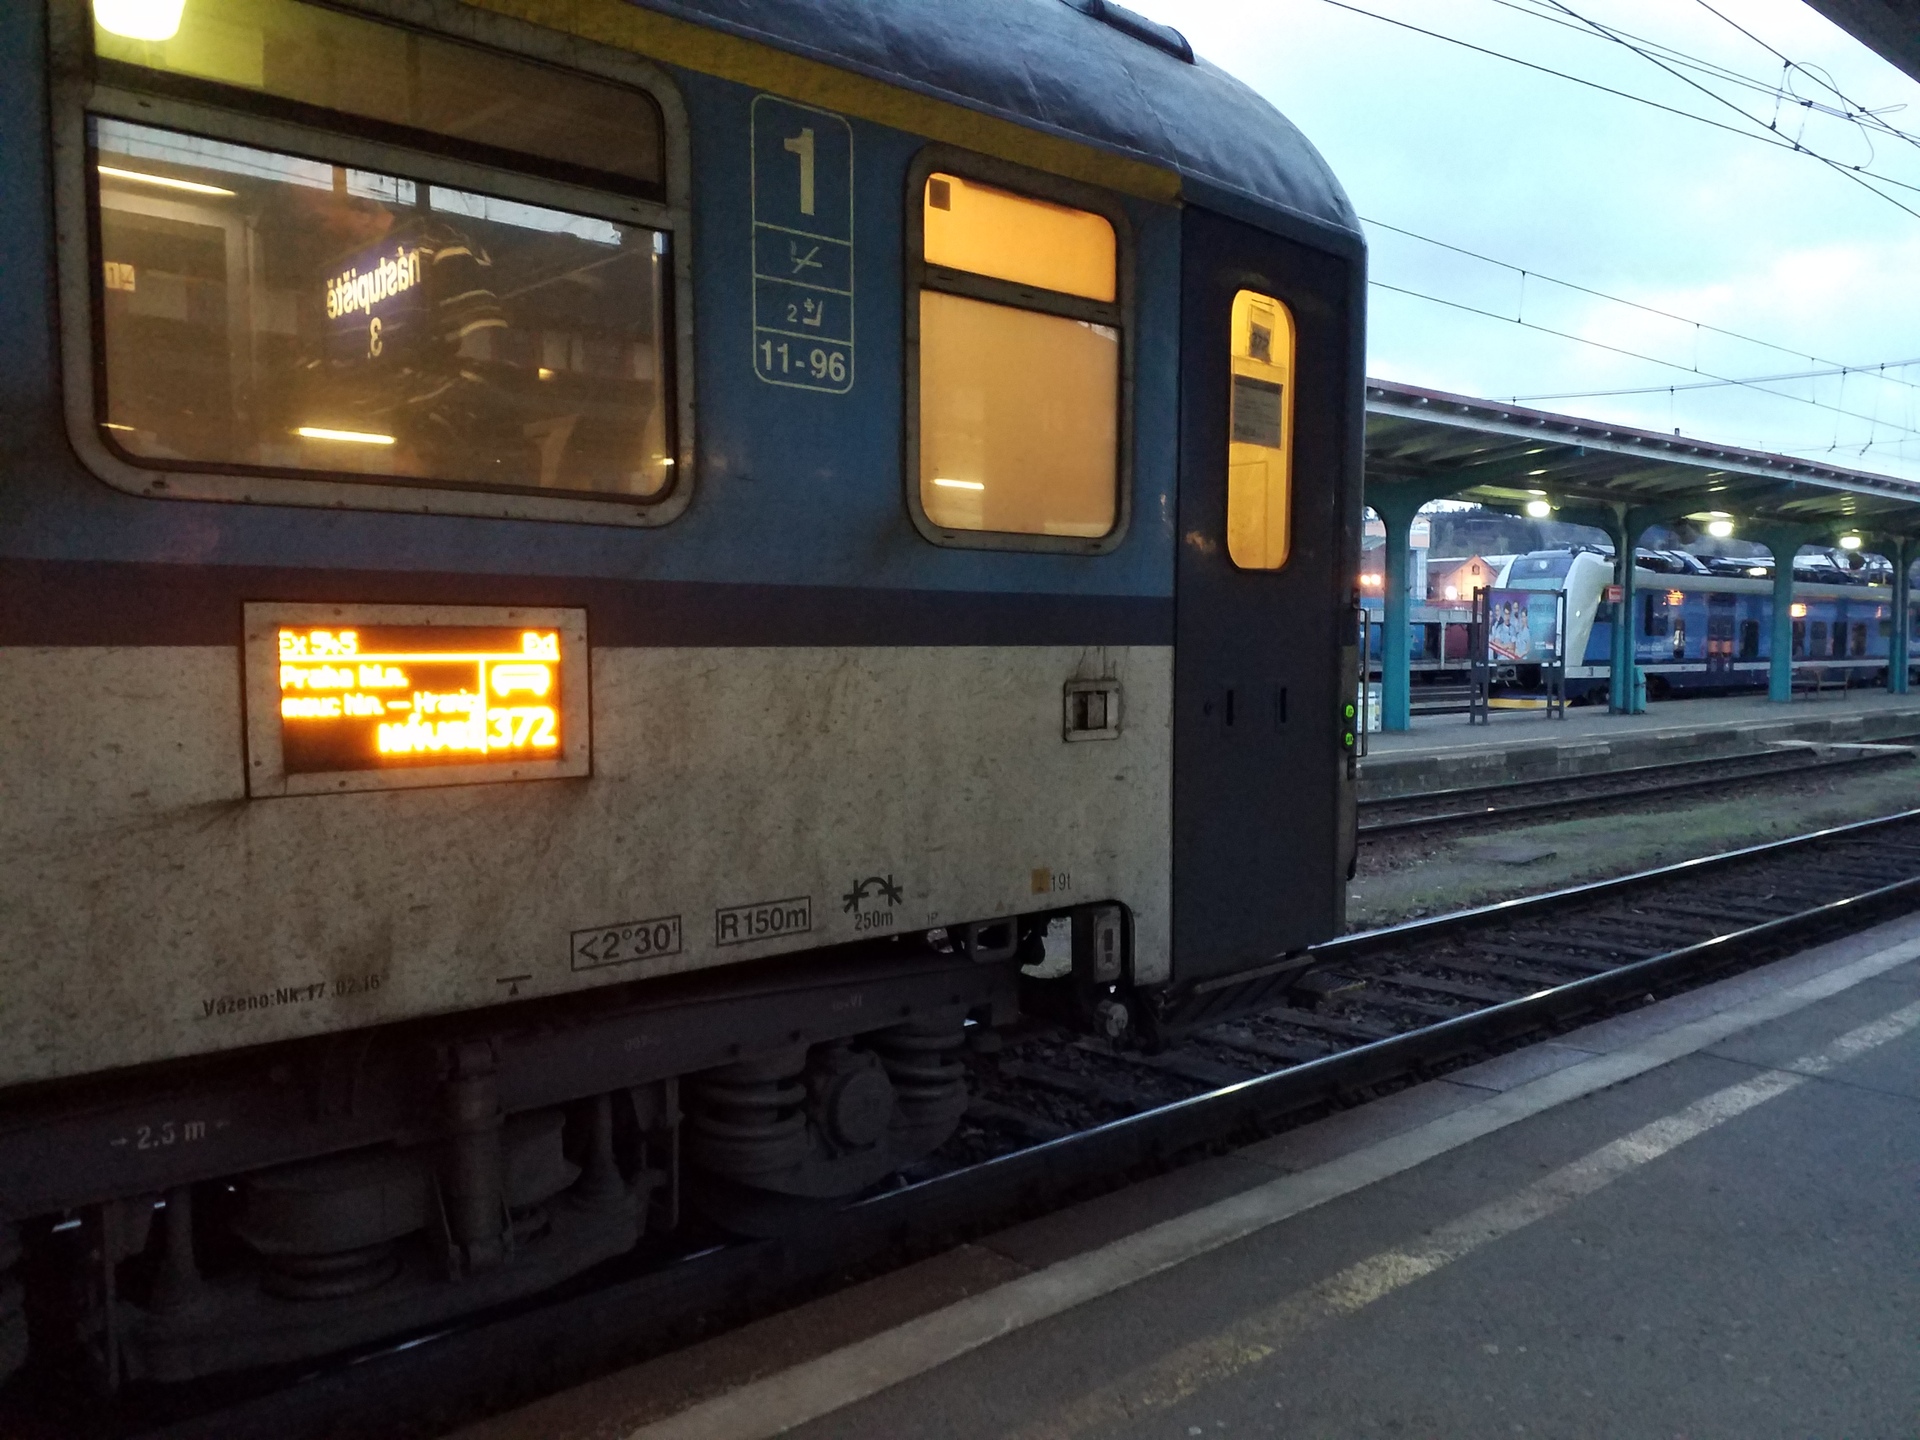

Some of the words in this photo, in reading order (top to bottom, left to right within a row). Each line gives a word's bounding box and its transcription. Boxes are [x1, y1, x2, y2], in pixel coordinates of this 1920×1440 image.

[783, 127, 815, 216] 1
[787, 303, 798, 323] 2
[759, 340, 846, 382] 11-96
[280, 664, 354, 689] Praha
[487, 706, 558, 748] 372
[854, 911, 894, 932] 250m
[184, 1120, 206, 1142] m
